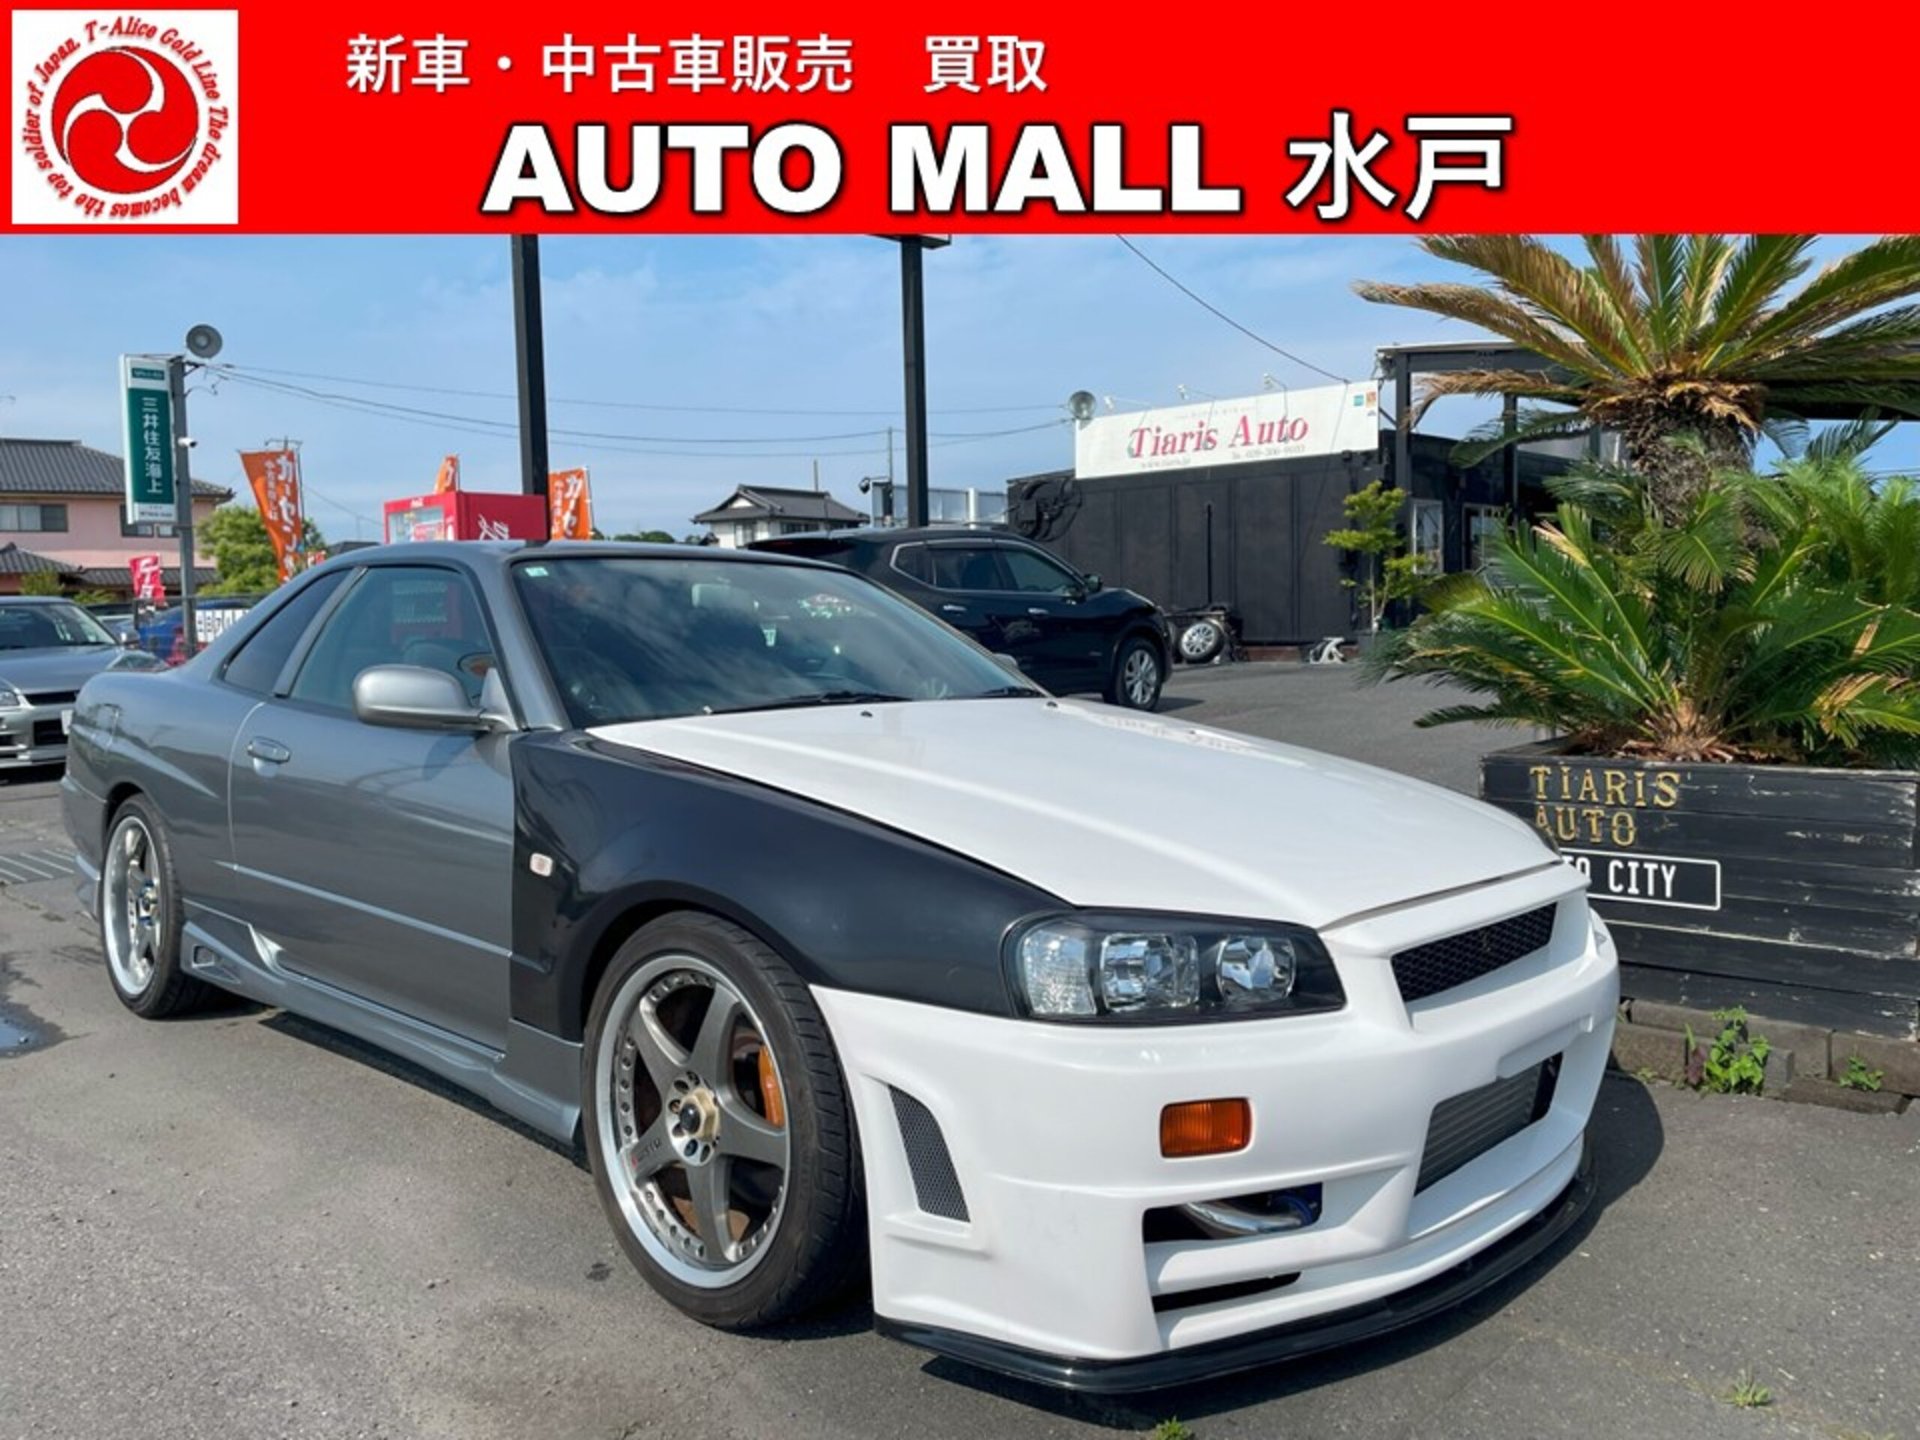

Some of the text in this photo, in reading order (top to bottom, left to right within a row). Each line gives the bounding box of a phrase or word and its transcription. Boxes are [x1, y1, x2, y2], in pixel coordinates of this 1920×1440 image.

[141, 397, 163, 494] 三井住友海上
[1129, 414, 1309, 458] Tiaris Auto
[1529, 764, 1680, 808] TIARIS
[1535, 805, 1637, 846] AUTO
[1607, 859, 1677, 898] CITY
